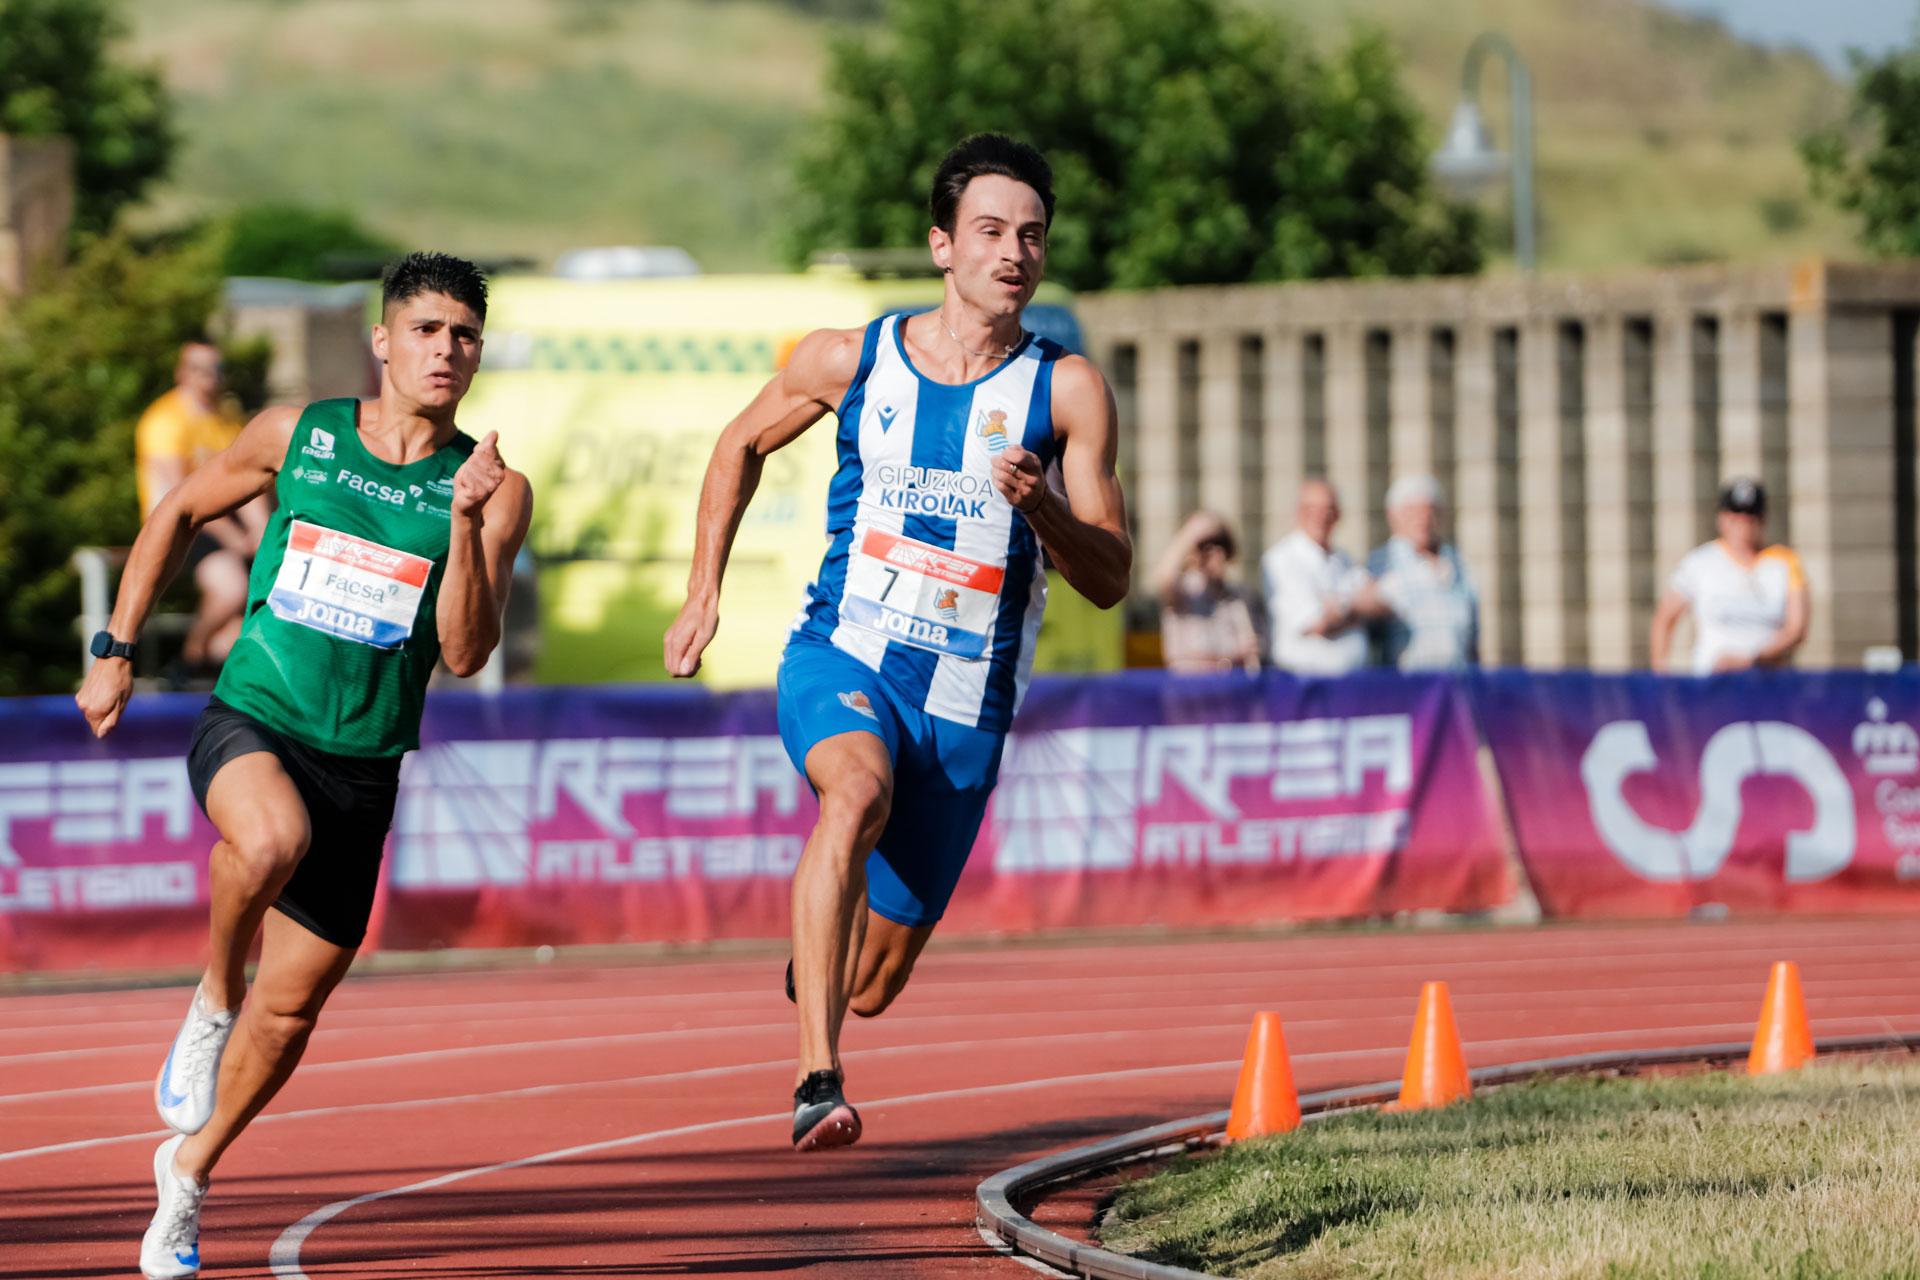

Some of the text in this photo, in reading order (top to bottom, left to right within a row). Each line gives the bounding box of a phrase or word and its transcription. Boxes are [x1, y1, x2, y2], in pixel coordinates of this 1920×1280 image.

[336, 468, 406, 506] Facsa
[877, 465, 994, 498] GIPUZKOA
[880, 488, 987, 519] KIROLAK
[298, 556, 313, 591] 1
[920, 550, 980, 575] RFEA
[325, 573, 385, 604] Facsa
[880, 565, 899, 603] 7
[1142, 714, 1413, 821] RFEA
[0, 757, 193, 850] FEA
[536, 735, 800, 839] RFEA
